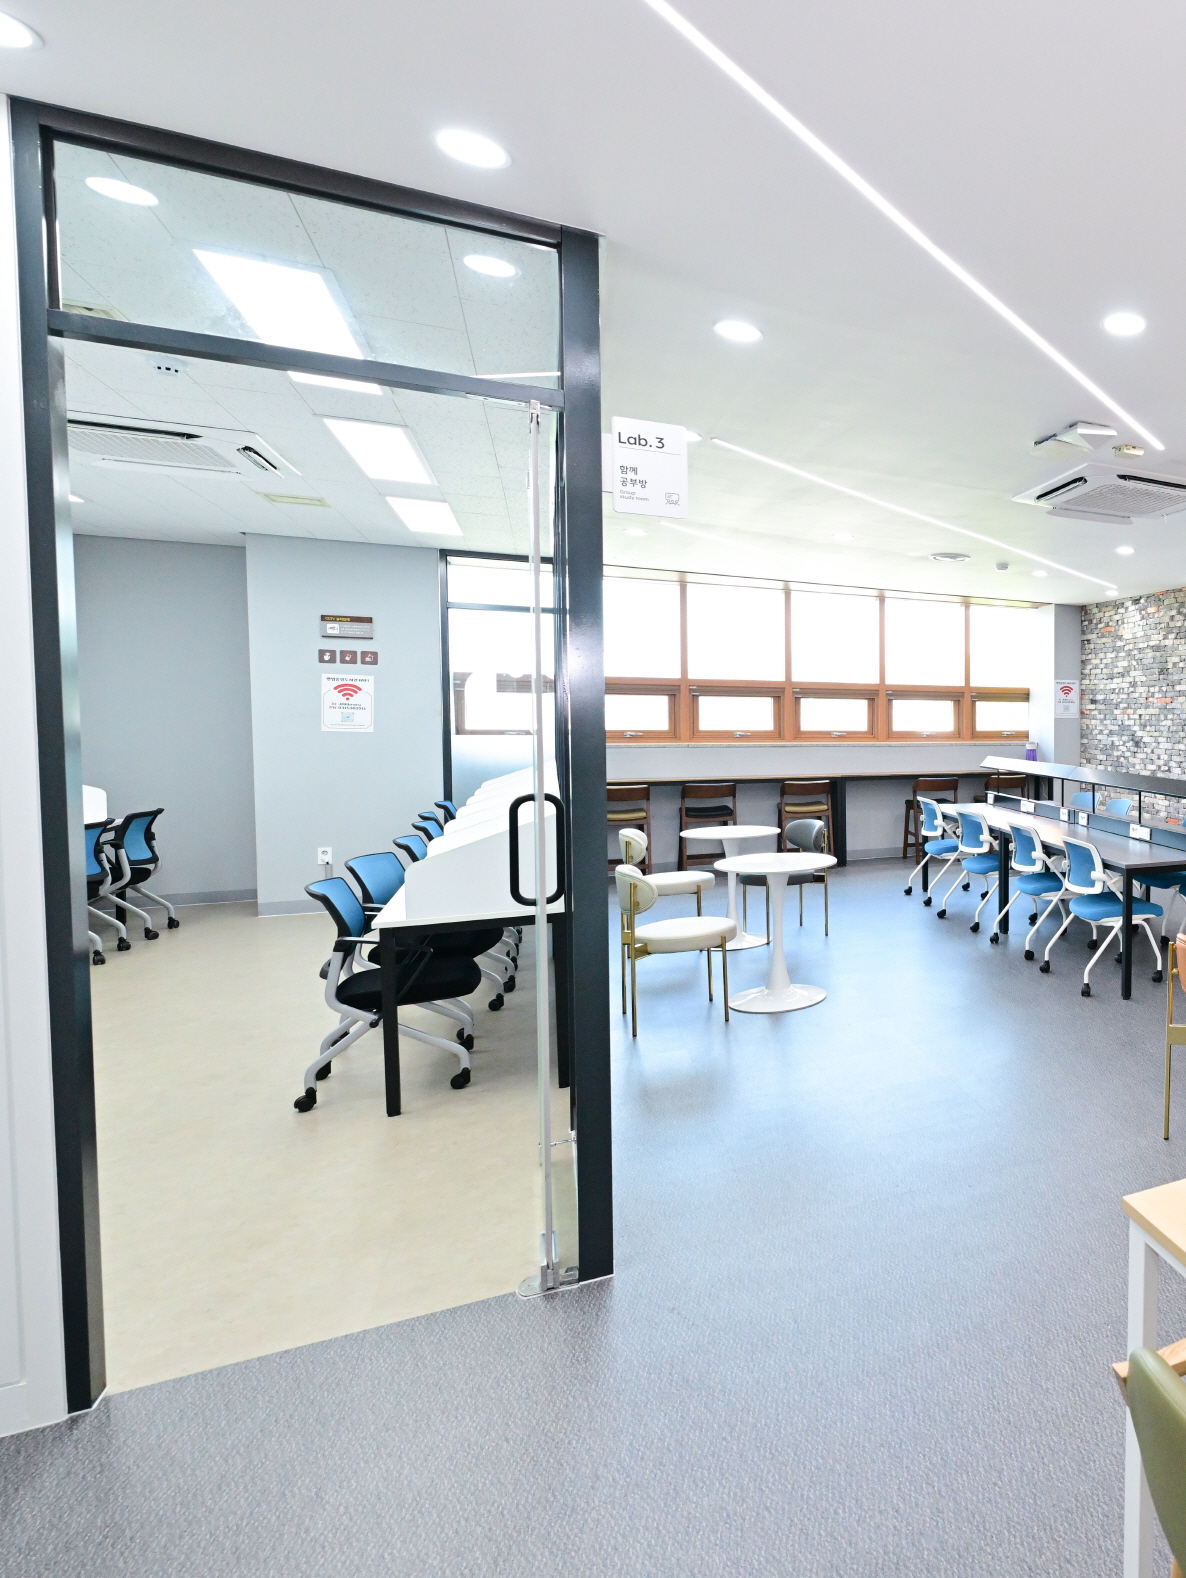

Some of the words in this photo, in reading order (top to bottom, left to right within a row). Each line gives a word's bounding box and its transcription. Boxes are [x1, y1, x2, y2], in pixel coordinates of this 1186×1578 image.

[618, 431, 653, 447] Lab.
[655, 436, 665, 449] 3
[619, 465, 638, 476] 함께
[619, 476, 648, 489] 공부방
